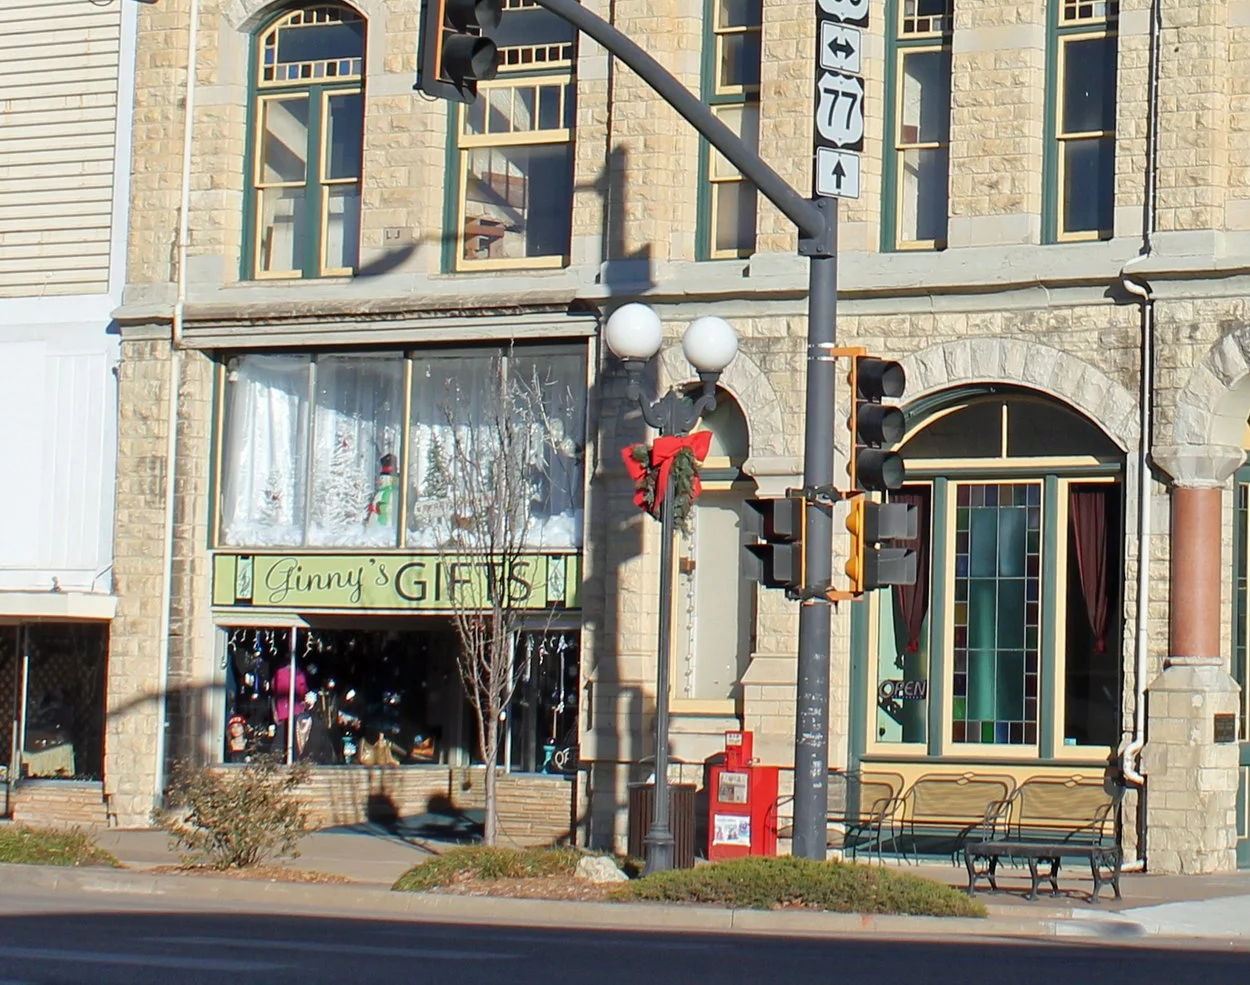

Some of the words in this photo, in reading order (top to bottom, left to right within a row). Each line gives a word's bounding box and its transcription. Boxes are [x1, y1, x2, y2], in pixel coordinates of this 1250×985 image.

[823, 87, 858, 130] 77
[265, 557, 390, 604] Ginny's
[394, 561, 532, 602] GIFTS
[879, 680, 926, 699] OPEN
